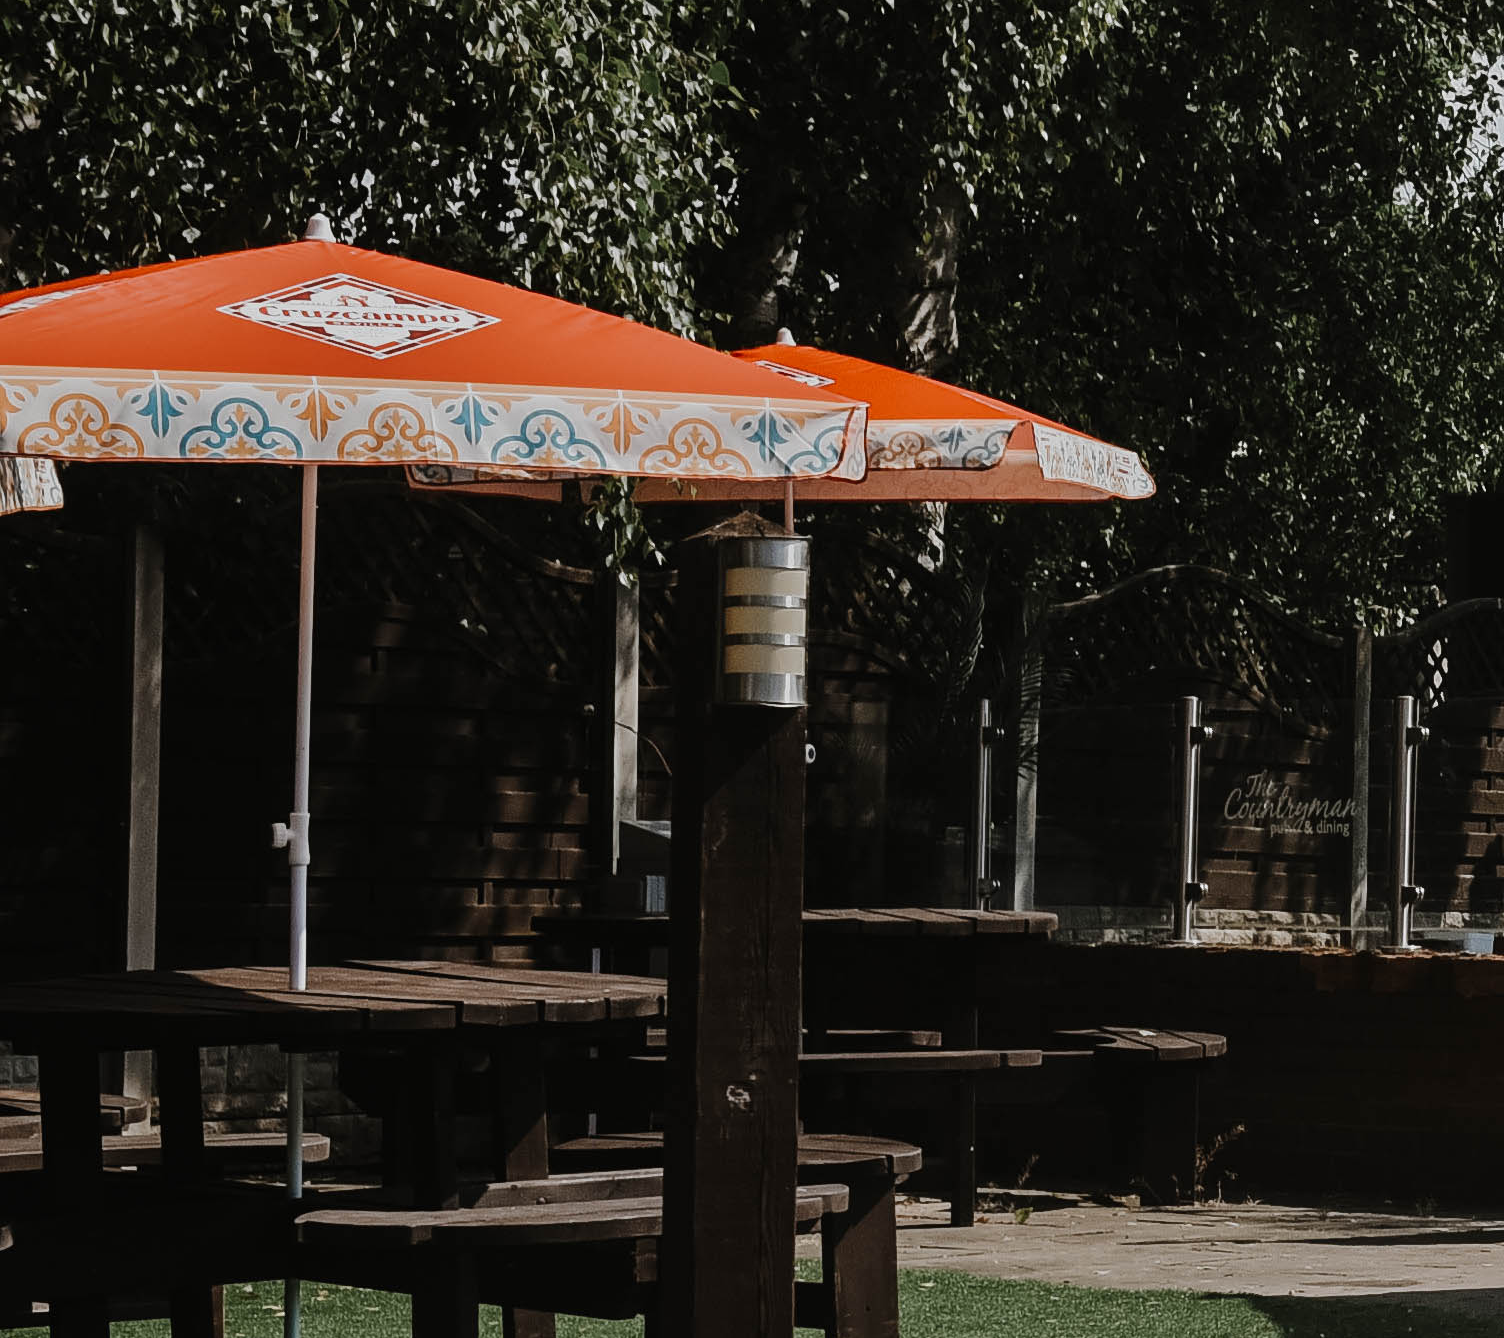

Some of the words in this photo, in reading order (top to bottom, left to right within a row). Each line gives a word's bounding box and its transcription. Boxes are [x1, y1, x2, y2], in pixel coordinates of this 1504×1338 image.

[259, 305, 460, 324] Cruzcampo
[1245, 768, 1278, 798] The
[1223, 786, 1358, 830] Countryman
[1316, 820, 1350, 838] dining
